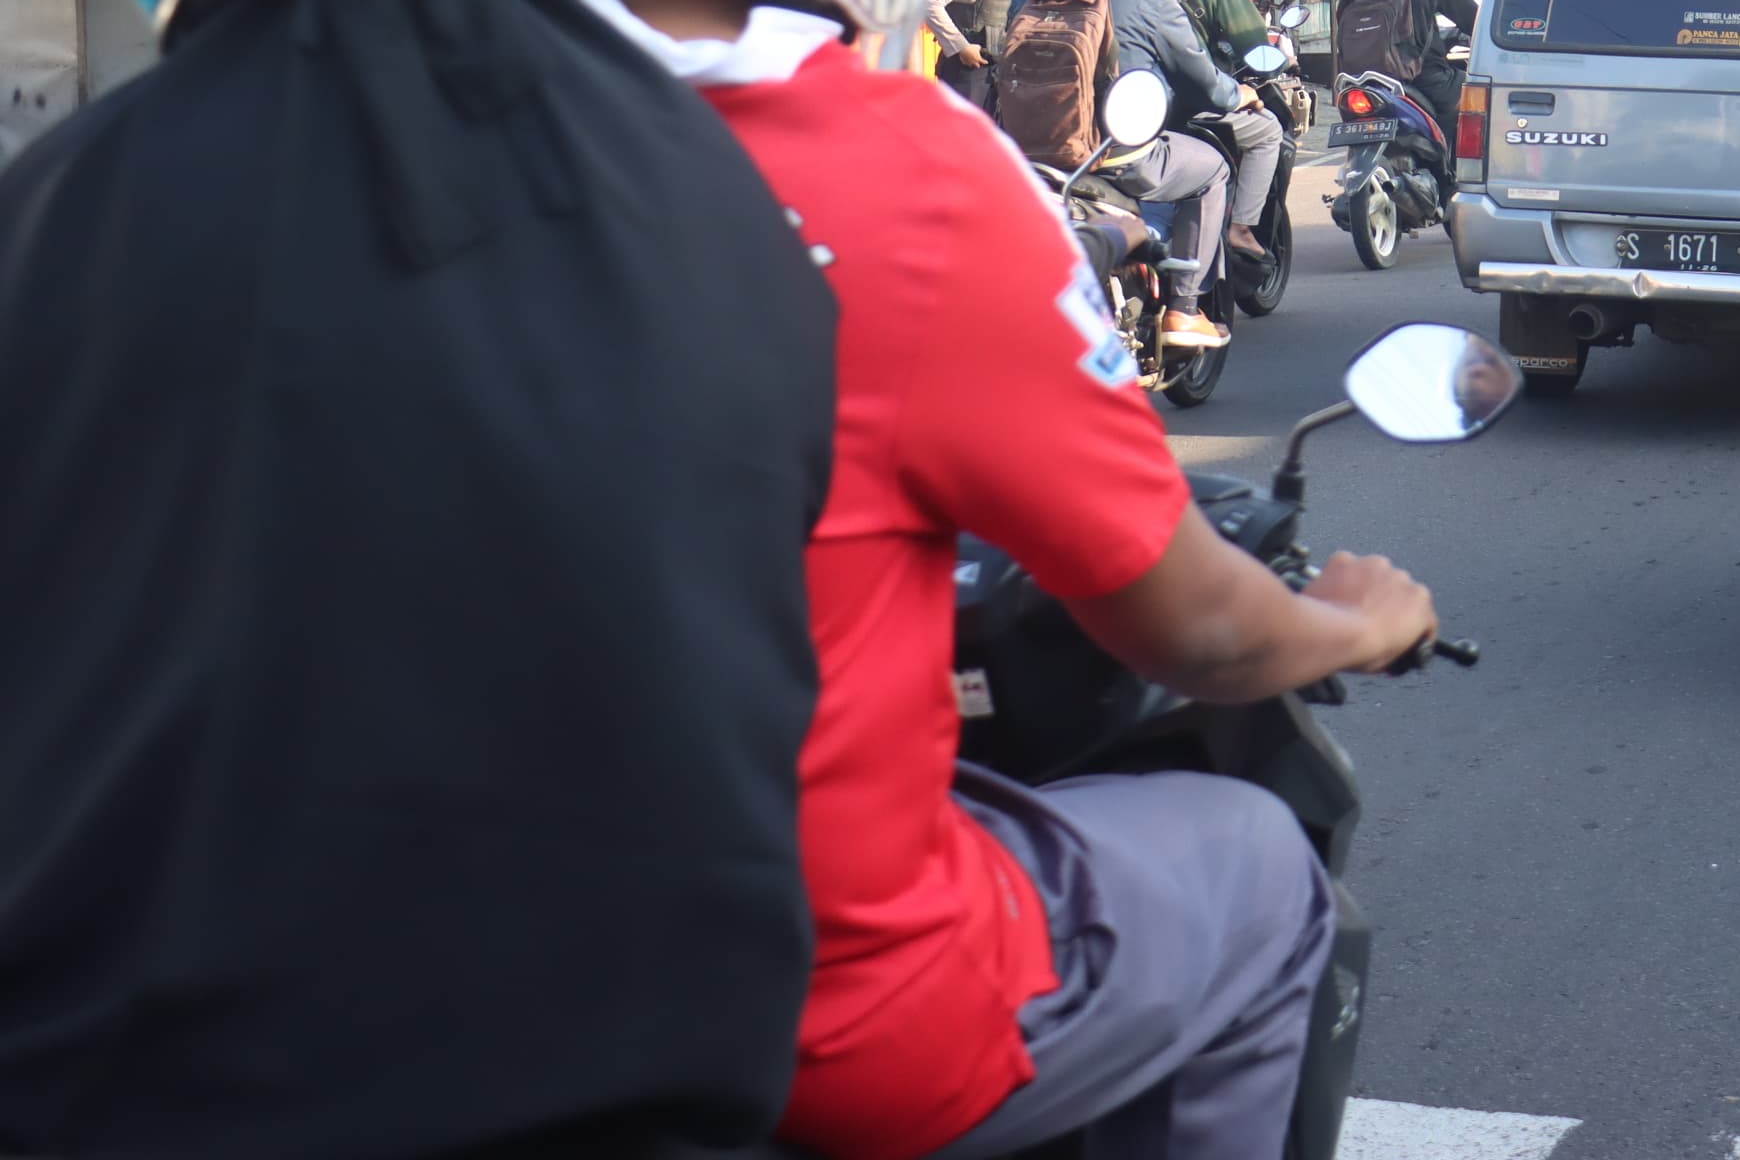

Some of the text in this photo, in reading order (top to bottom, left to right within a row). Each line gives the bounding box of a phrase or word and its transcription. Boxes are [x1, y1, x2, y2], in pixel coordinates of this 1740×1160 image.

[1506, 130, 1607, 146] SUZUKI
[1627, 233, 1640, 260] S
[1667, 234, 1718, 263] 1671
